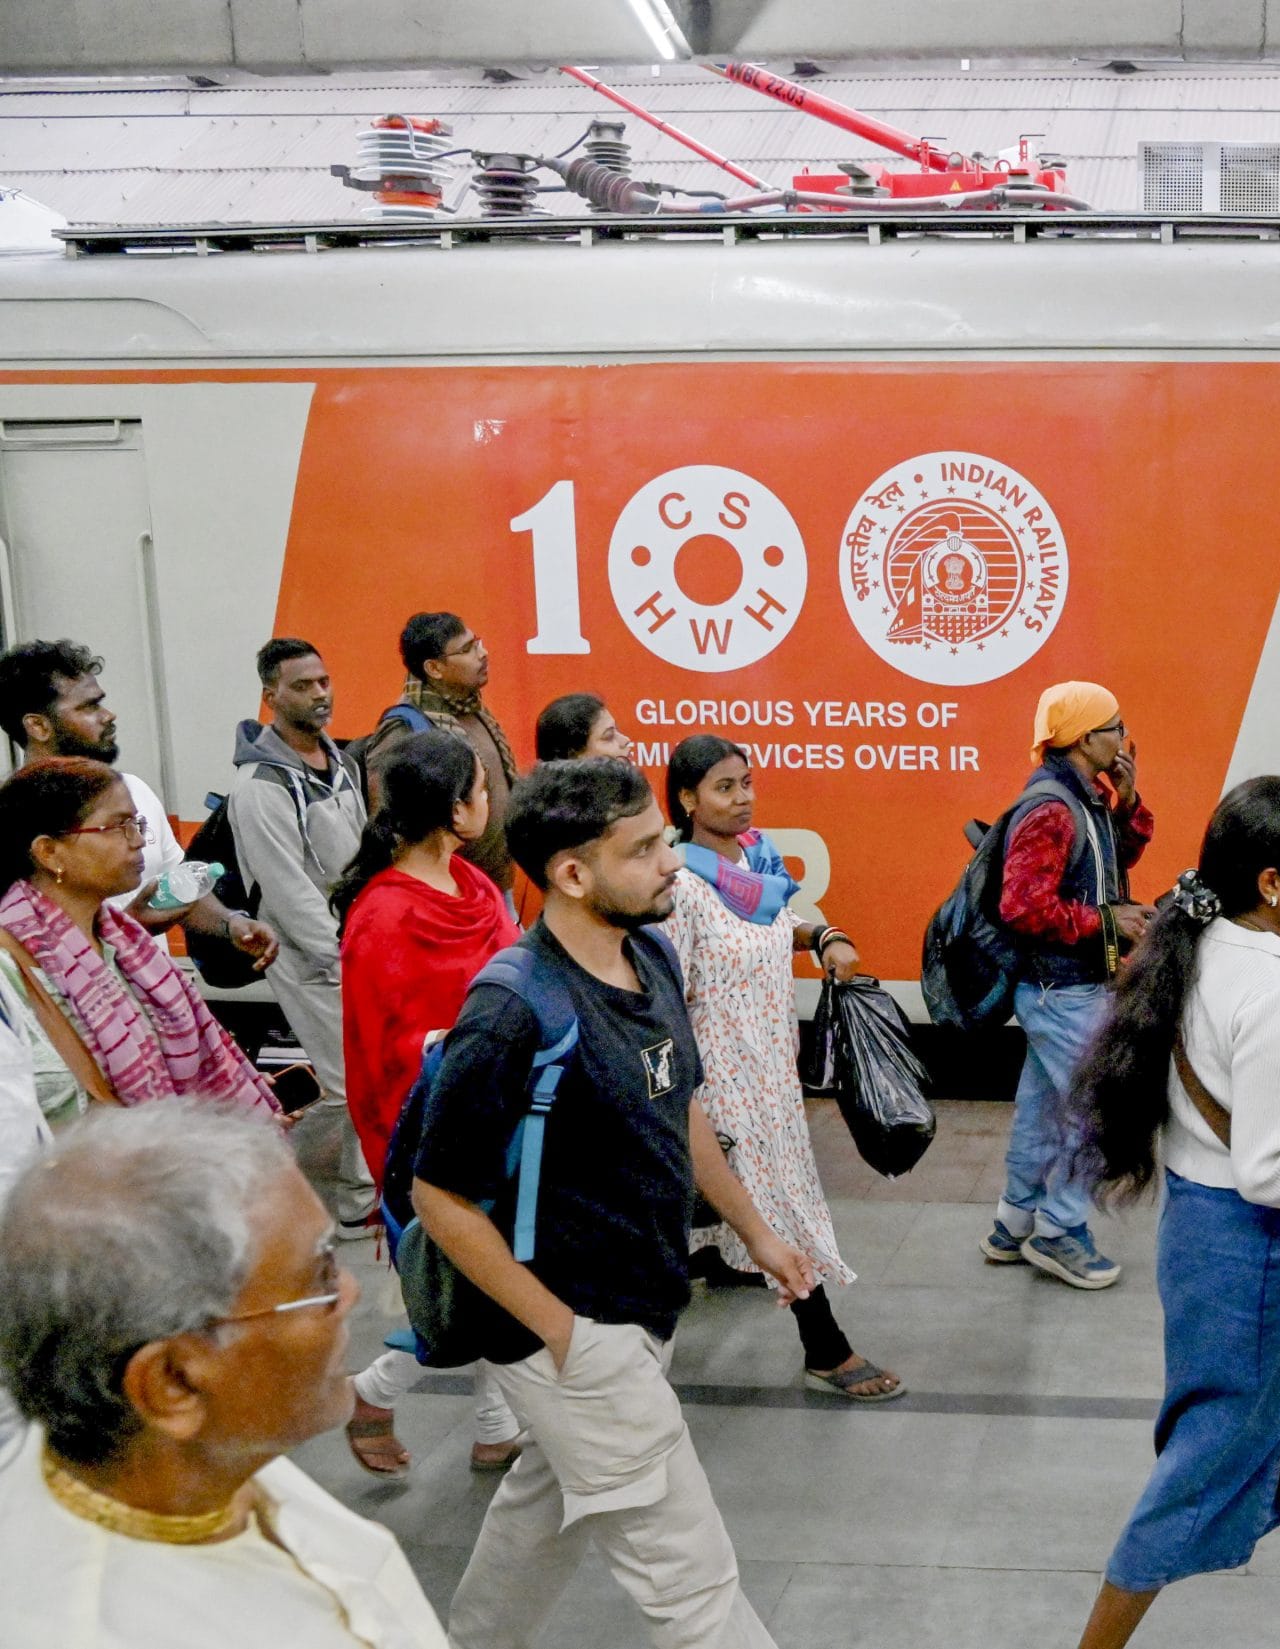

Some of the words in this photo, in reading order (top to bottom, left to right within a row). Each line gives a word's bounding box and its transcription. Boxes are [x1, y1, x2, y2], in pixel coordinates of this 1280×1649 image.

[765, 77, 806, 106] 22.03
[846, 514, 877, 602] भारतीय
[864, 481, 905, 510] रेल
[941, 462, 1027, 508] INDIAN
[1023, 506, 1059, 633] RAILWAYS
[635, 699, 794, 726] GLORIOUS
[803, 701, 906, 728] YEARS
[916, 702, 959, 728] OF
[734, 743, 844, 769] RVICES
[854, 745, 940, 771] OVER
[950, 746, 980, 771] IR
[1108, 945, 1117, 972] Nikon
